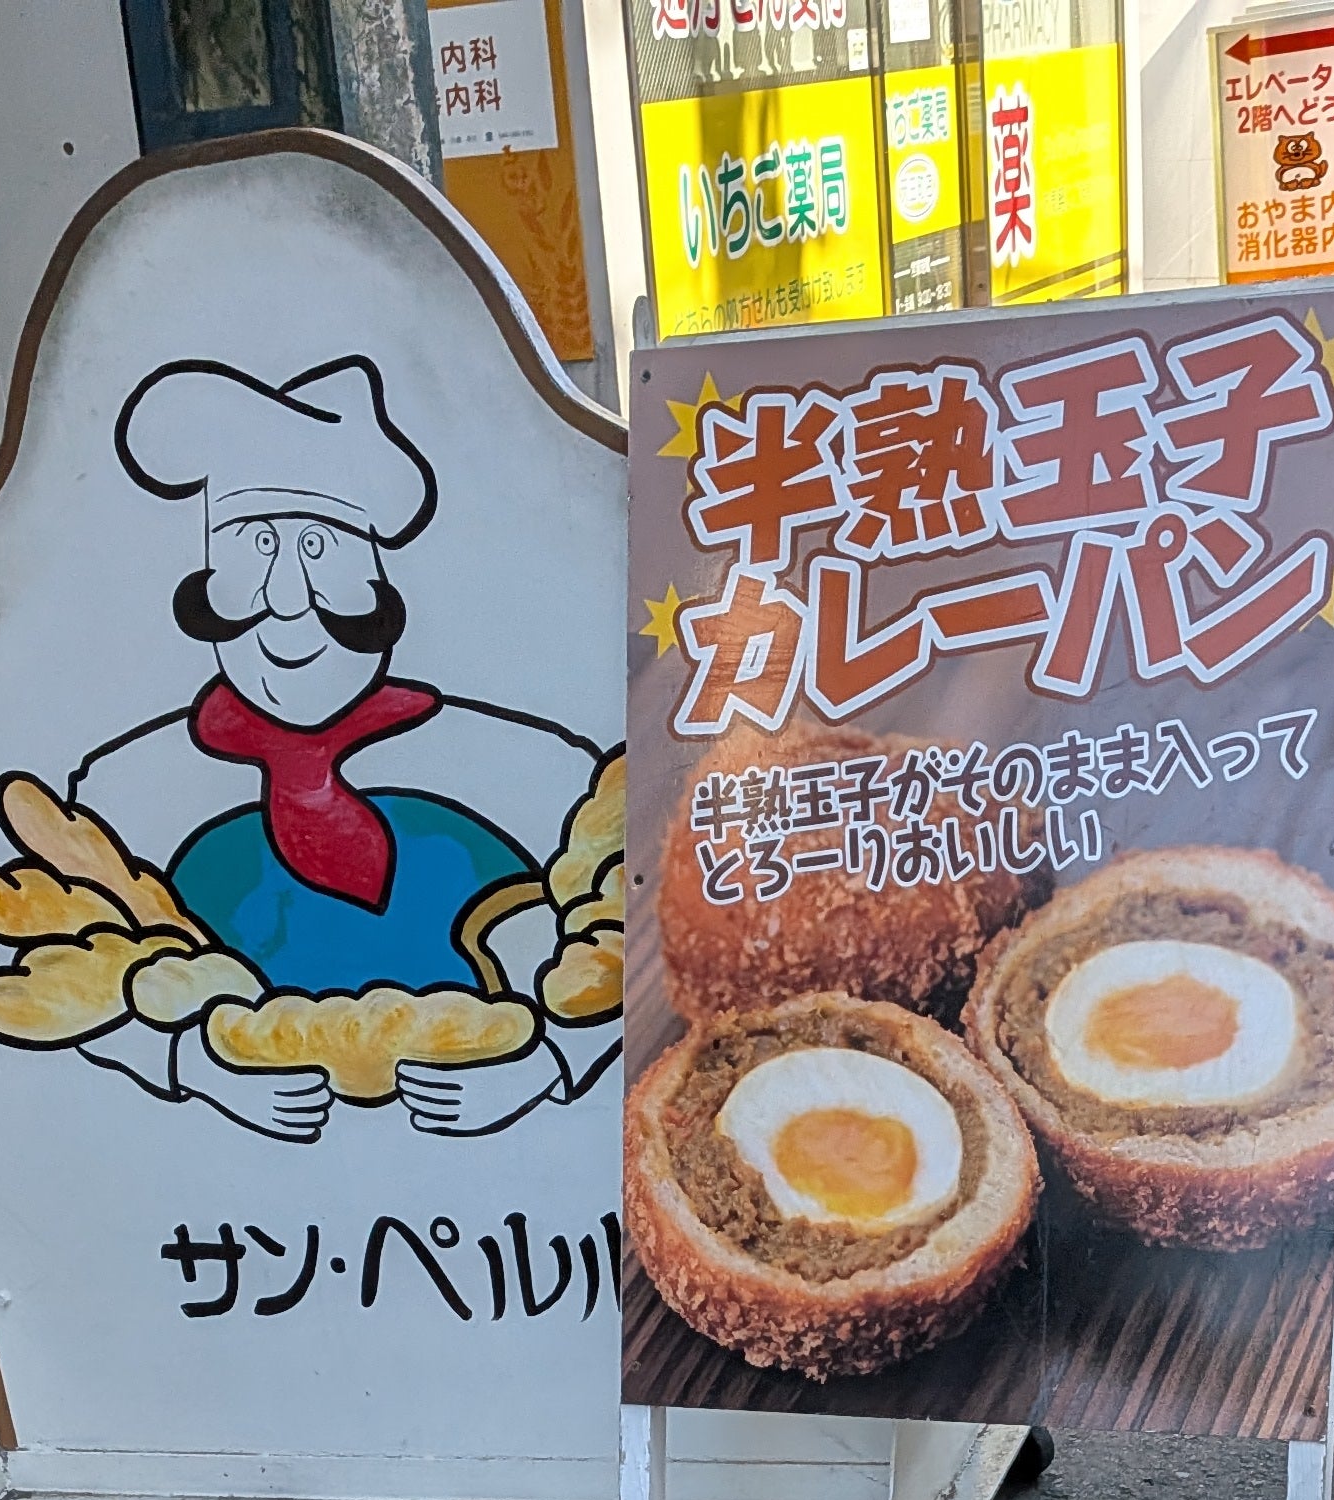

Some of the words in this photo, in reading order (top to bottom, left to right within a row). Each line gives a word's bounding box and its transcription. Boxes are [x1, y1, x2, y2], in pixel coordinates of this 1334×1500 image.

[434, 77, 502, 117] 内科
[440, 35, 498, 75] 内科
[680, 139, 848, 266] いちご薬局
[990, 92, 1033, 256] 薬
[685, 315, 1334, 566] 半熟玉子
[671, 507, 1330, 736] カレーパン
[690, 708, 1319, 840] 半熟玉子がそのまま入って
[694, 806, 1104, 906] とろーりおいしい
